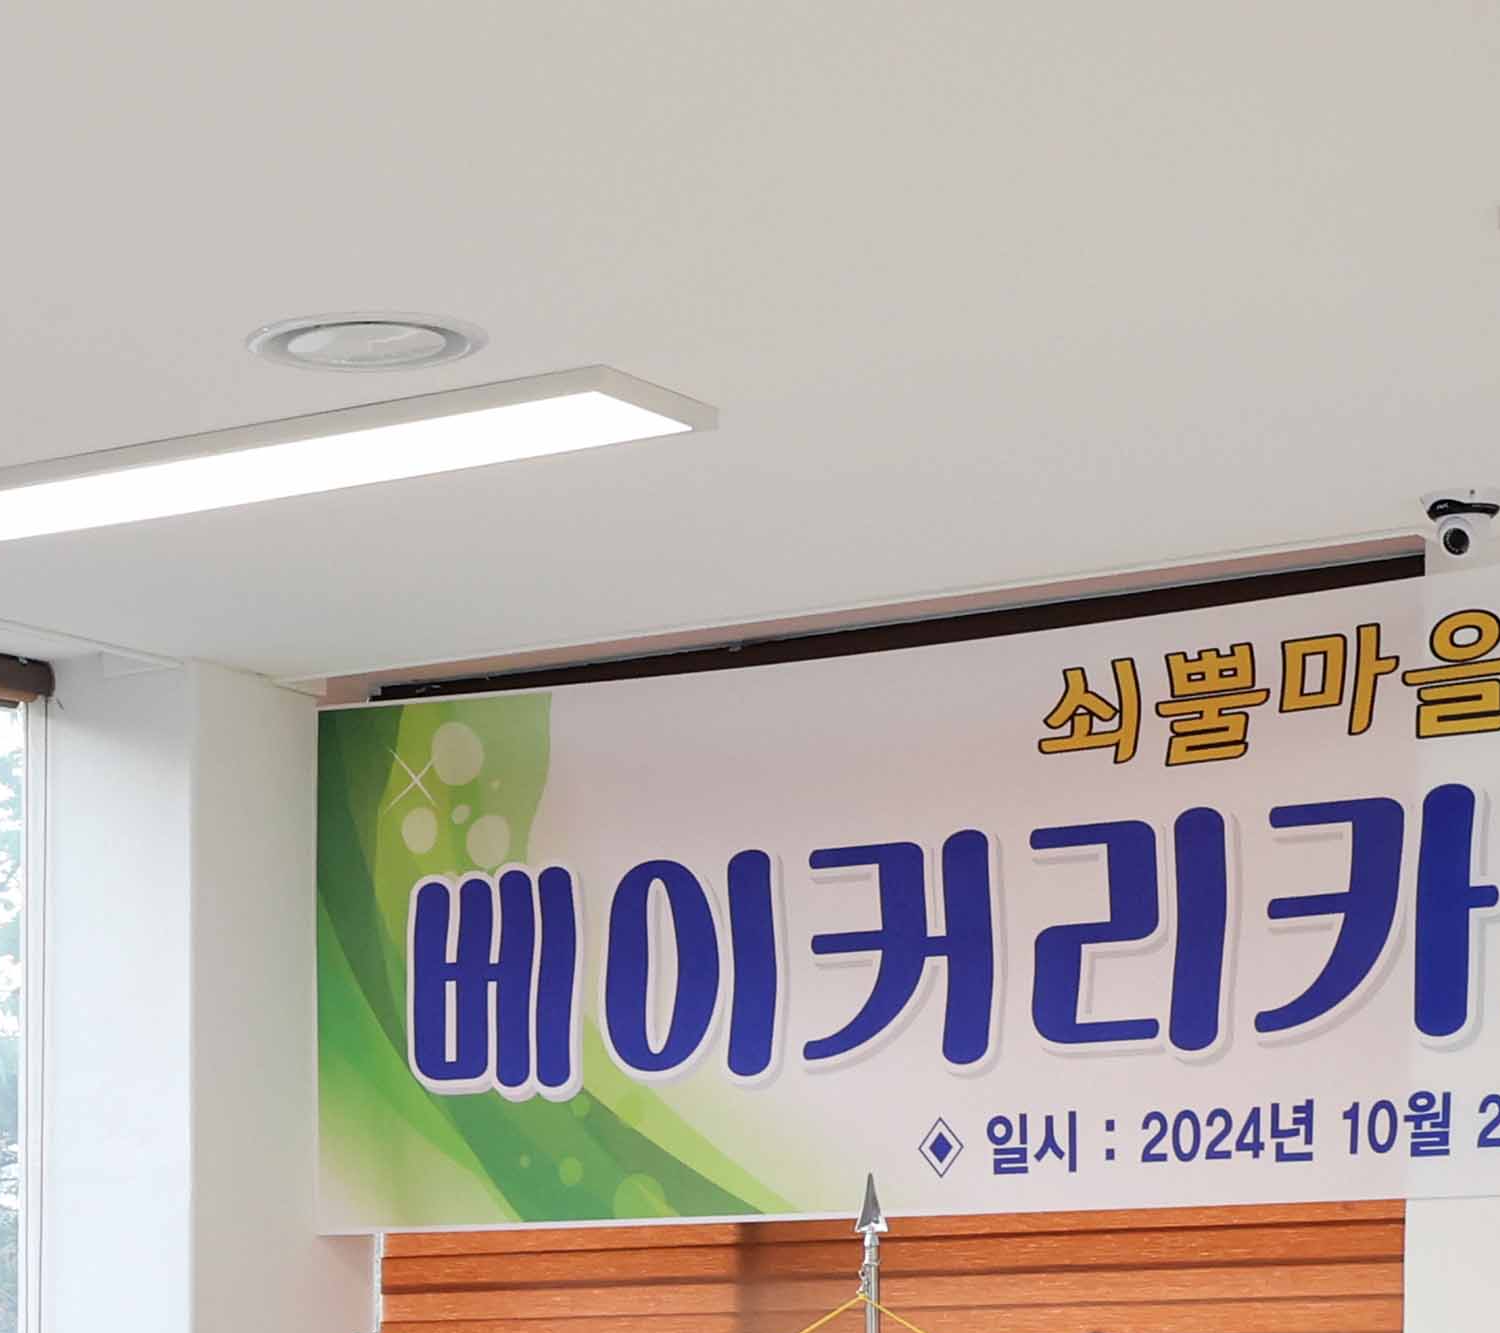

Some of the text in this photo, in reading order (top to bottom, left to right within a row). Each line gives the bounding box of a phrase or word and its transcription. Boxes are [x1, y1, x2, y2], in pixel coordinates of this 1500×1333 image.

[986, 1113, 1077, 1175] 일시
[1141, 1098, 1315, 1163] 2024년
[1344, 1090, 1452, 1158] 10월
